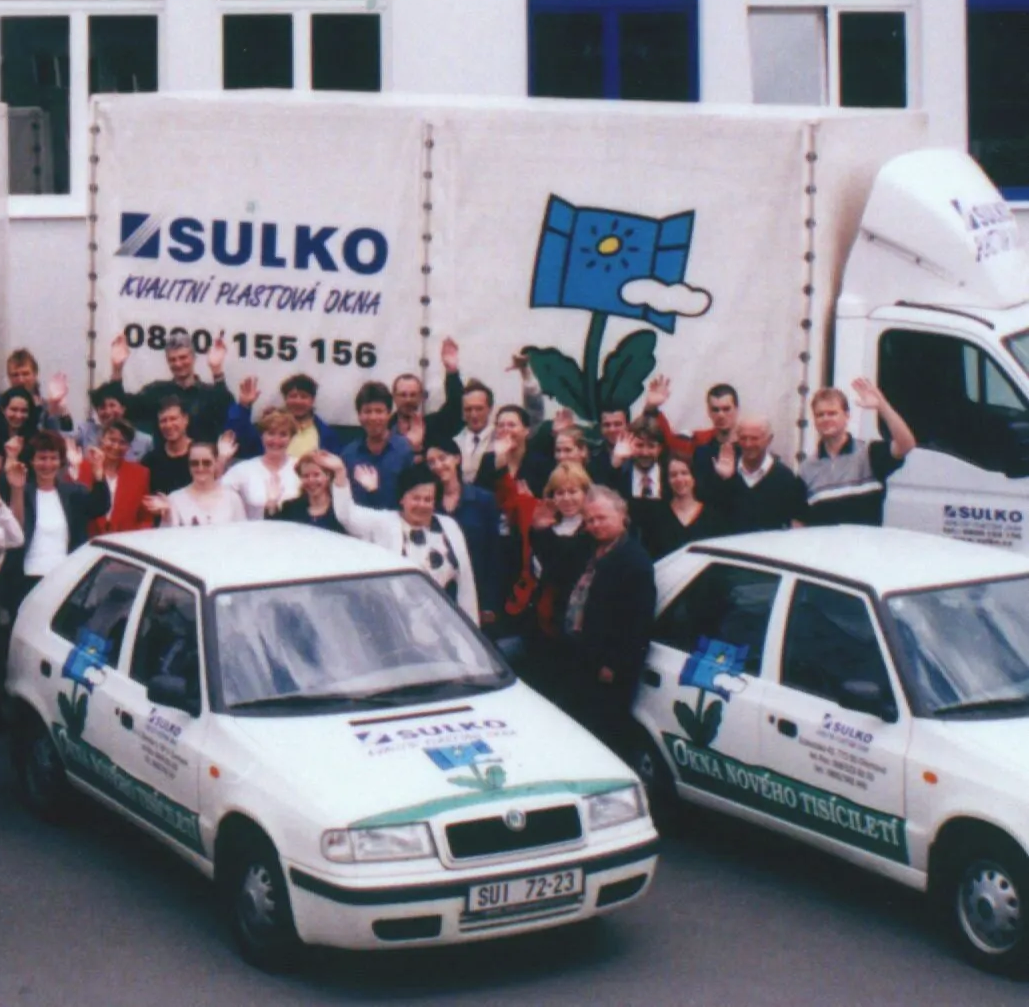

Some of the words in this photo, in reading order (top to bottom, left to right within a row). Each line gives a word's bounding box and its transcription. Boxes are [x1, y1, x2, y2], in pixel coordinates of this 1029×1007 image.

[168, 217, 389, 275] SULKO
[120, 275, 215, 304] KVALITNÍ
[215, 282, 320, 311] PLASTOVÁ
[324, 290, 382, 316] OKNA
[124, 323, 298, 362] 080155
[310, 338, 378, 368] 156
[959, 506, 1022, 522] SULKO
[397, 720, 507, 738] SULKO
[833, 721, 874, 743] SULKO
[673, 739, 725, 782] OKNA
[724, 772, 798, 809] NOVÉHO
[799, 792, 900, 846] TISÍCILETÍ
[477, 882, 509, 907] SUI
[525, 871, 575, 899] 72-23
